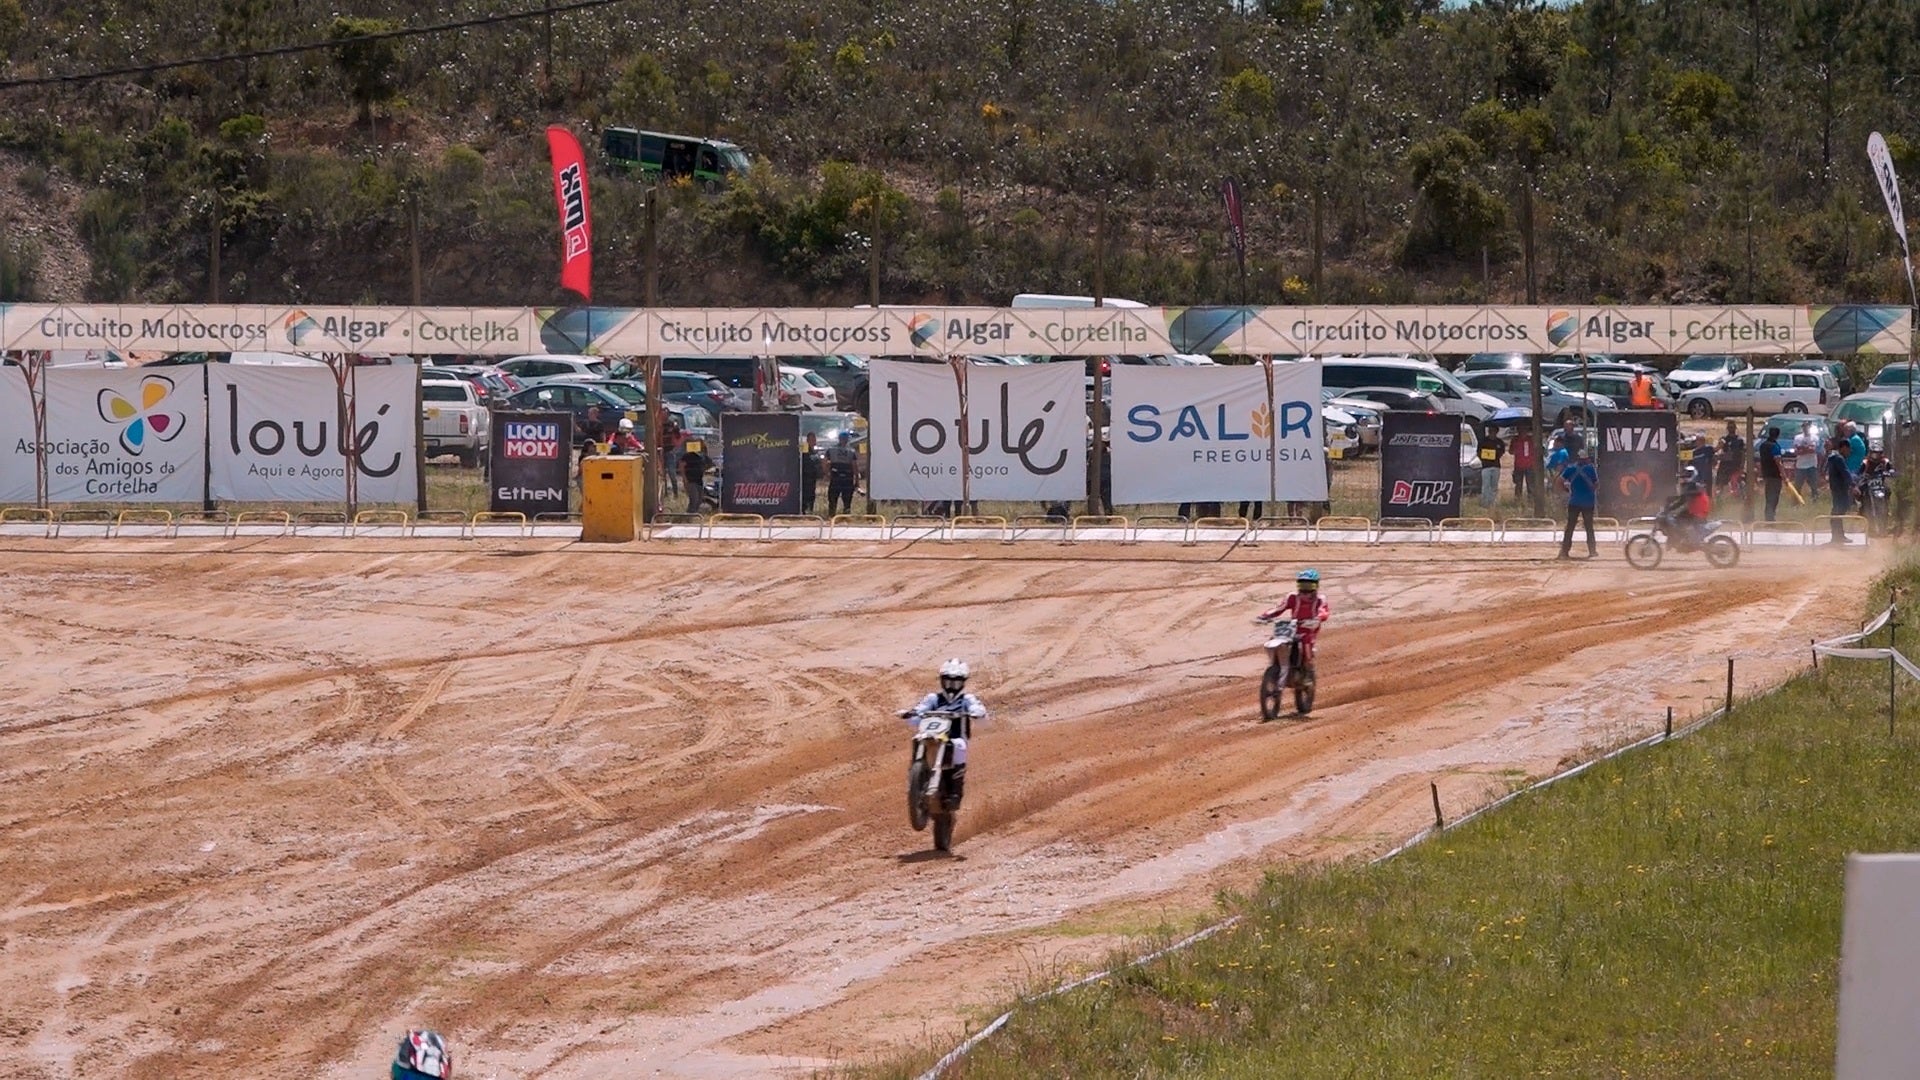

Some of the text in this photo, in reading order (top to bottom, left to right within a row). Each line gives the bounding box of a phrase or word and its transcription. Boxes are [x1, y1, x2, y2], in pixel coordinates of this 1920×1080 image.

[41, 315, 520, 342] Circuito Motocross Algar Cortelha
[660, 318, 1147, 344] Circuito Motocross Algar Cortelha
[1291, 315, 1791, 344] Circuito Motocross Algar Cortelha
[507, 424, 556, 440] LIQUI
[1606, 427, 1668, 452] M74
[507, 441, 557, 457] MOLY
[1193, 448, 1313, 463] FREGUESIA
[55, 458, 175, 480] dos Amigos da
[248, 463, 344, 481] Aqui e Agora
[909, 461, 943, 478] Aqui
[949, 465, 957, 476] e
[86, 478, 158, 495] Cortelha
[1389, 480, 1453, 508] DMX
